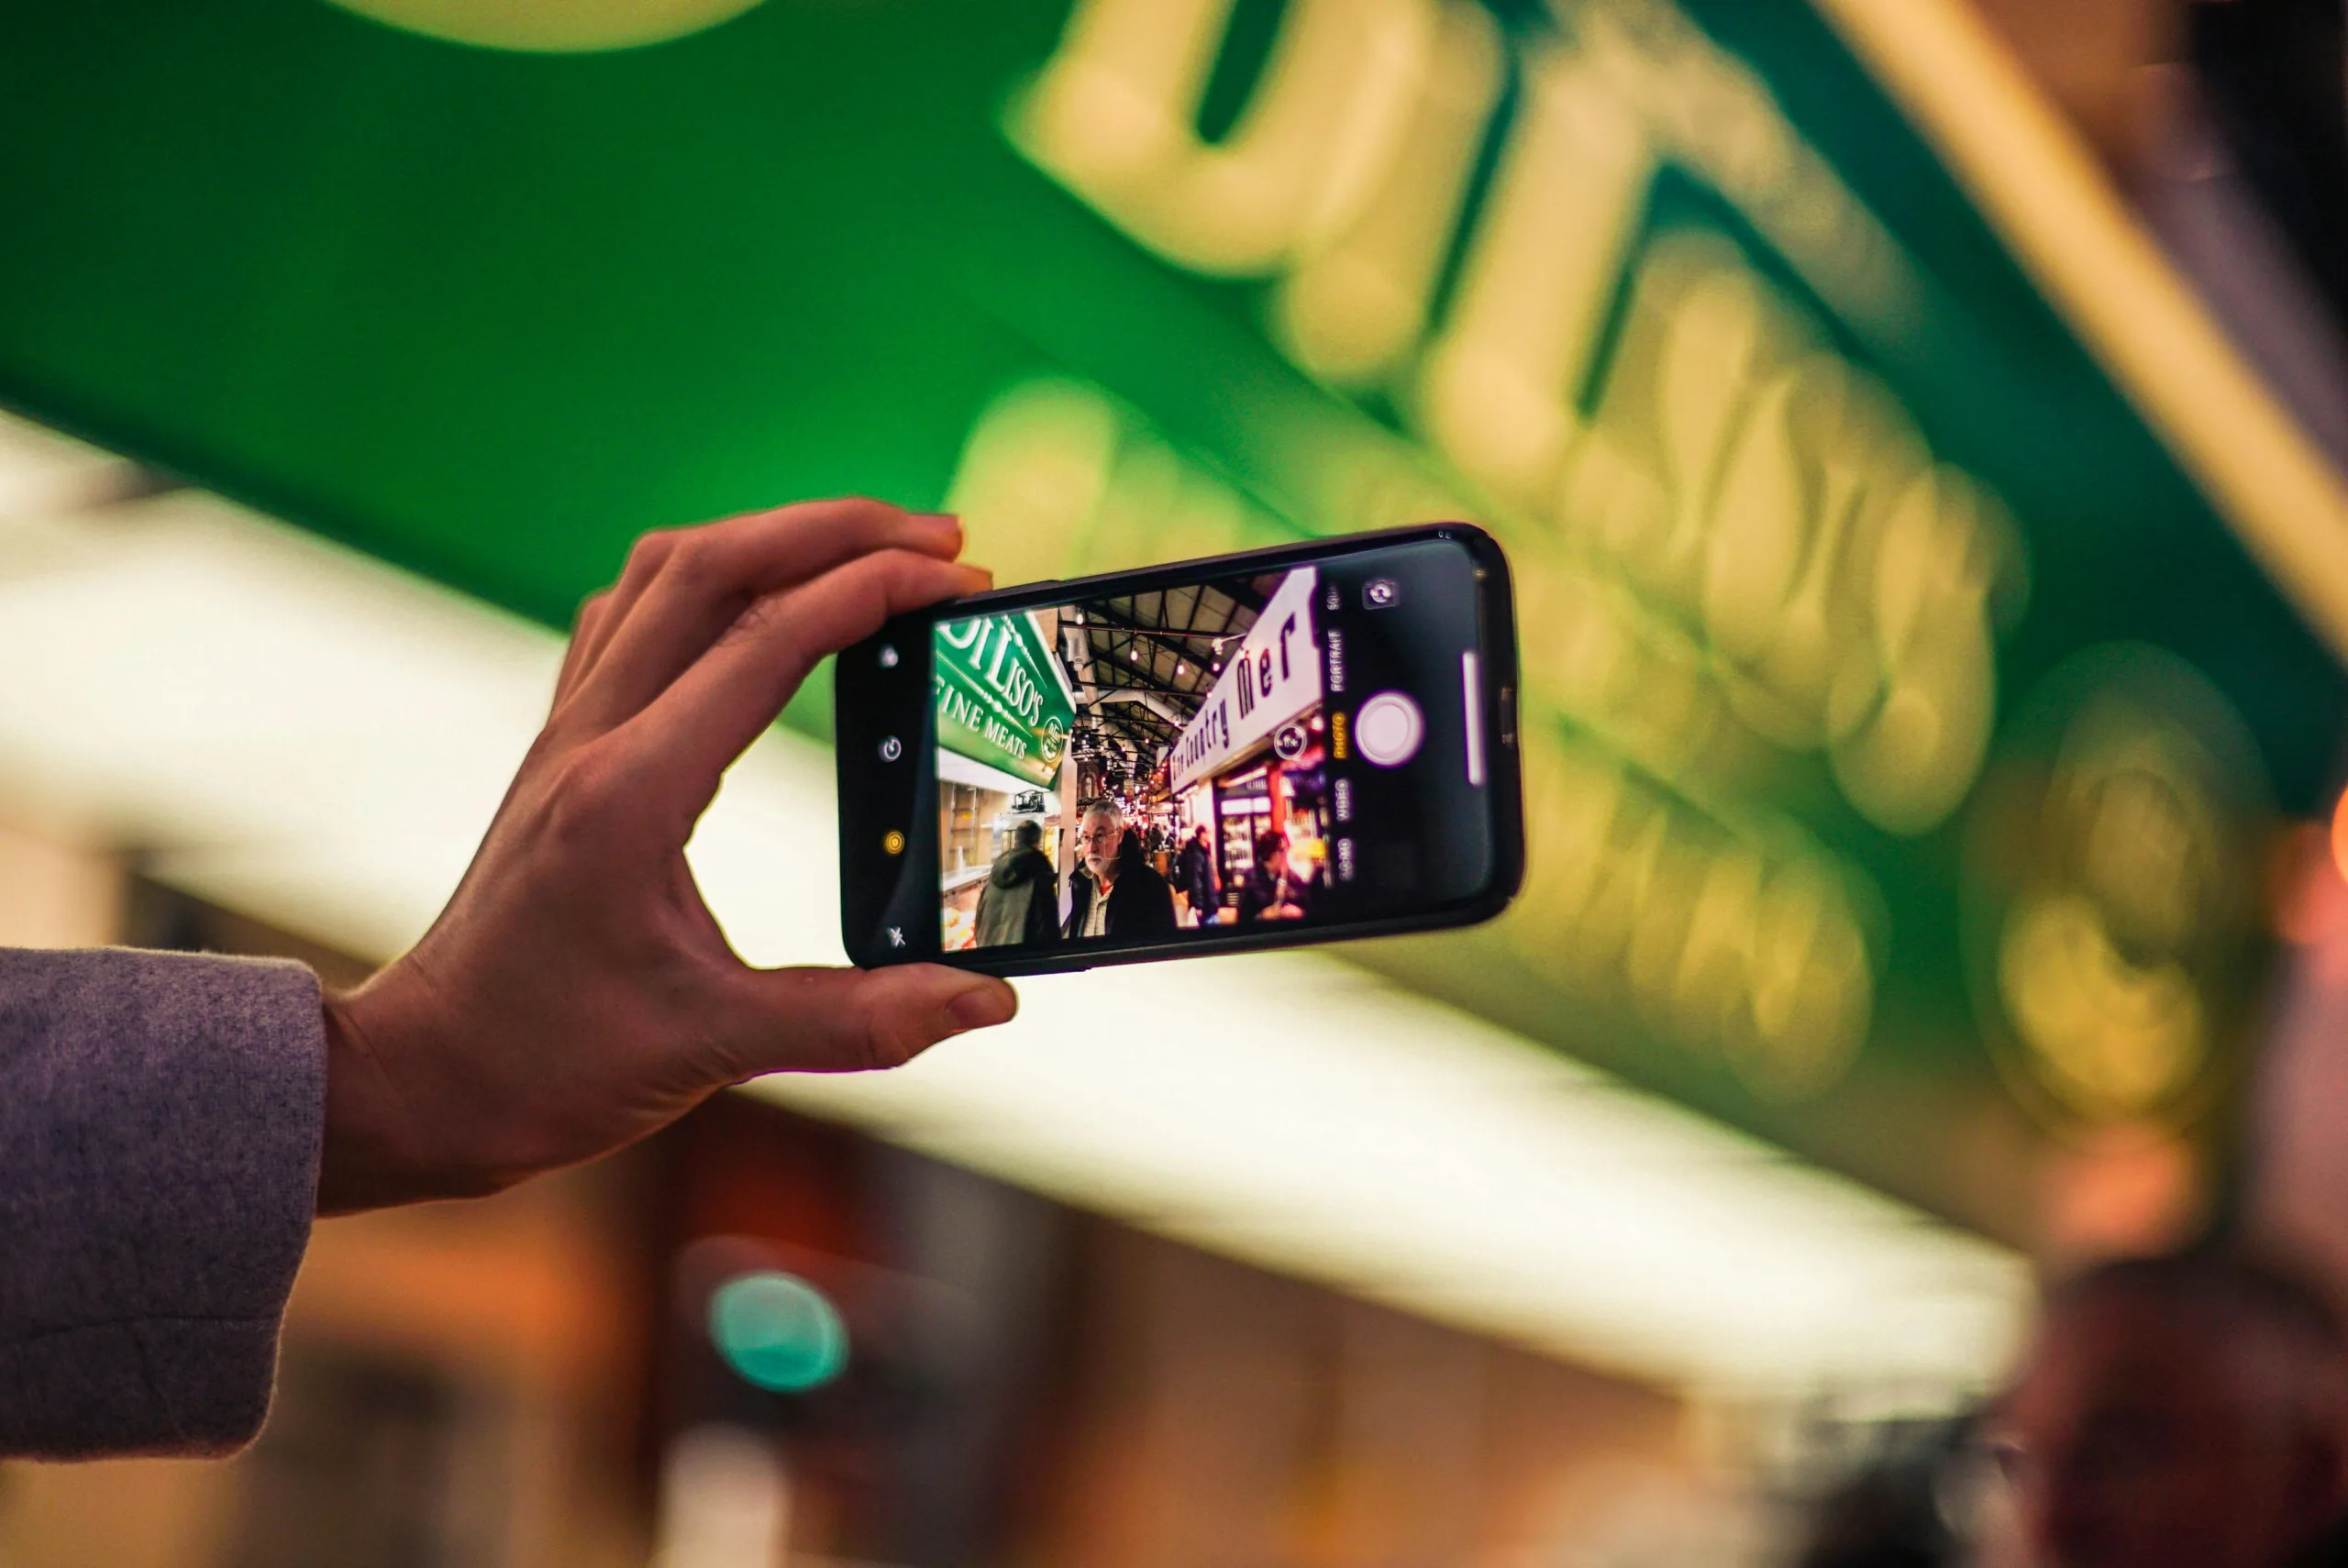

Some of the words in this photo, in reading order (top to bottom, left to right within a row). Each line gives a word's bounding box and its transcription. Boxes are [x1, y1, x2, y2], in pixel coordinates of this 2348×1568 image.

[1328, 630, 1345, 692] PORTRAIT
[984, 715, 1027, 759] MEATS
[1332, 712, 1347, 758] PHOTO
[1335, 778, 1351, 821] VIDEO
